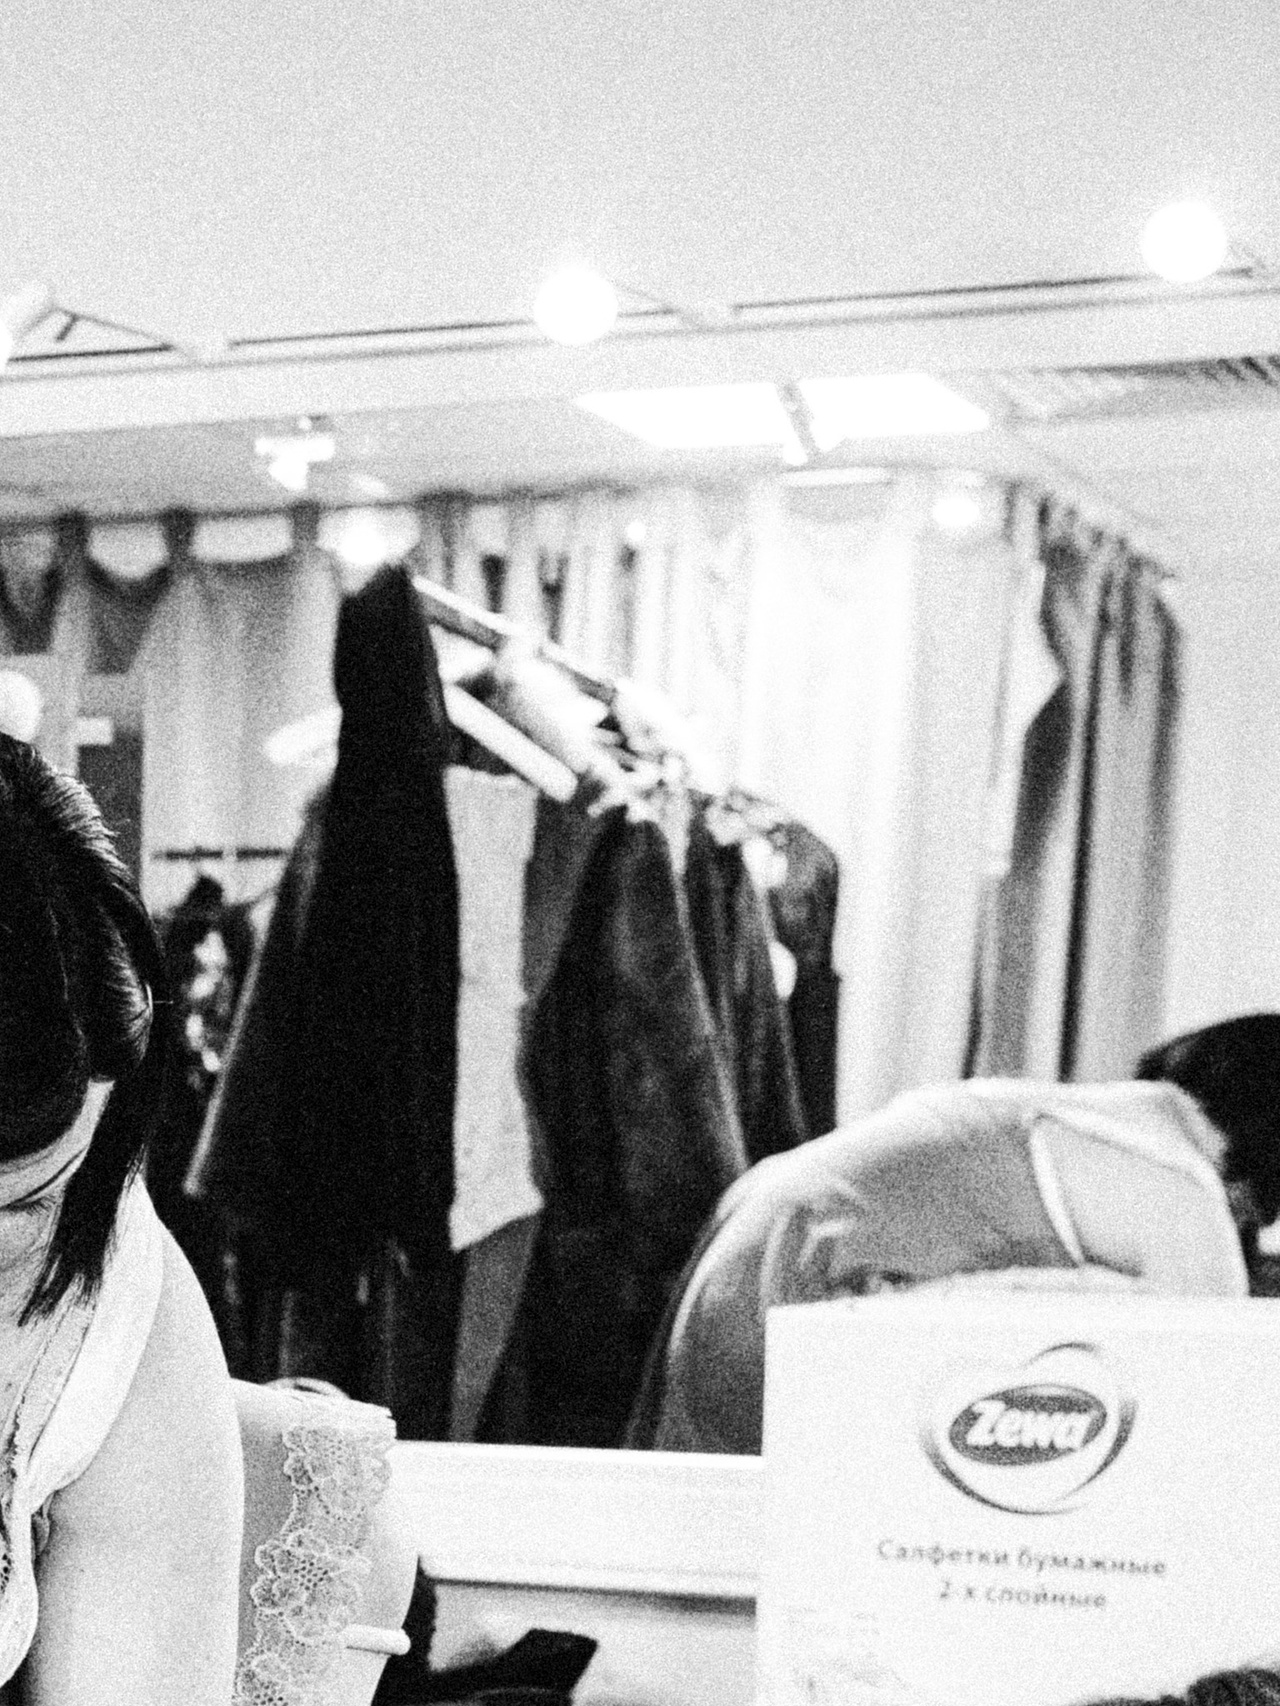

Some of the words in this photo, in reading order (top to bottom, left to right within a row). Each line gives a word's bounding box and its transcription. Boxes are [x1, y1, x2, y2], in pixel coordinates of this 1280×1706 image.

[964, 1399, 1096, 1449] Zewa
[876, 1538, 1010, 1567] Салфетки
[1017, 1544, 1167, 1577] бумажные
[984, 1582, 1107, 1608] слойные
